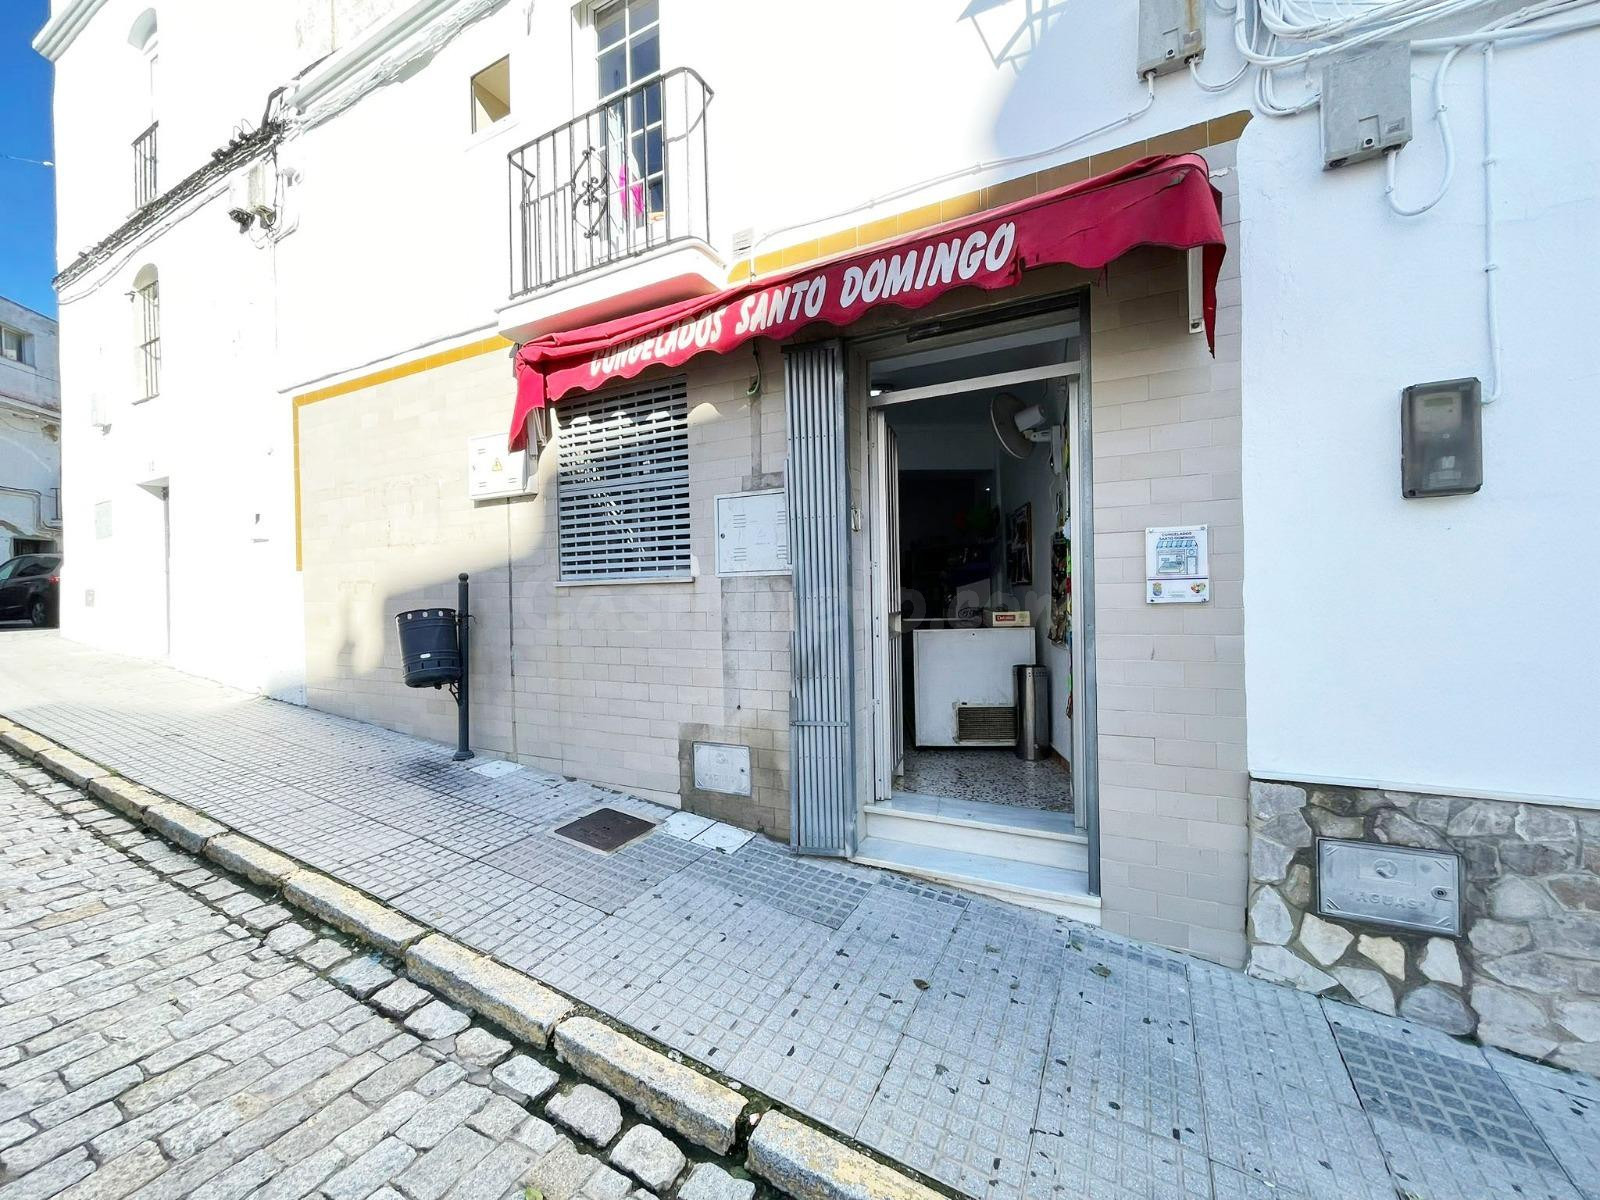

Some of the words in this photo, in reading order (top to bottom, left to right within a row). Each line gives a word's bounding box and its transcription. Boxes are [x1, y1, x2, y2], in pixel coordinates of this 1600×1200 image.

[590, 304, 728, 377] CONGELADOS
[735, 274, 827, 335] SANTO
[839, 221, 1016, 309] DOMINGO
